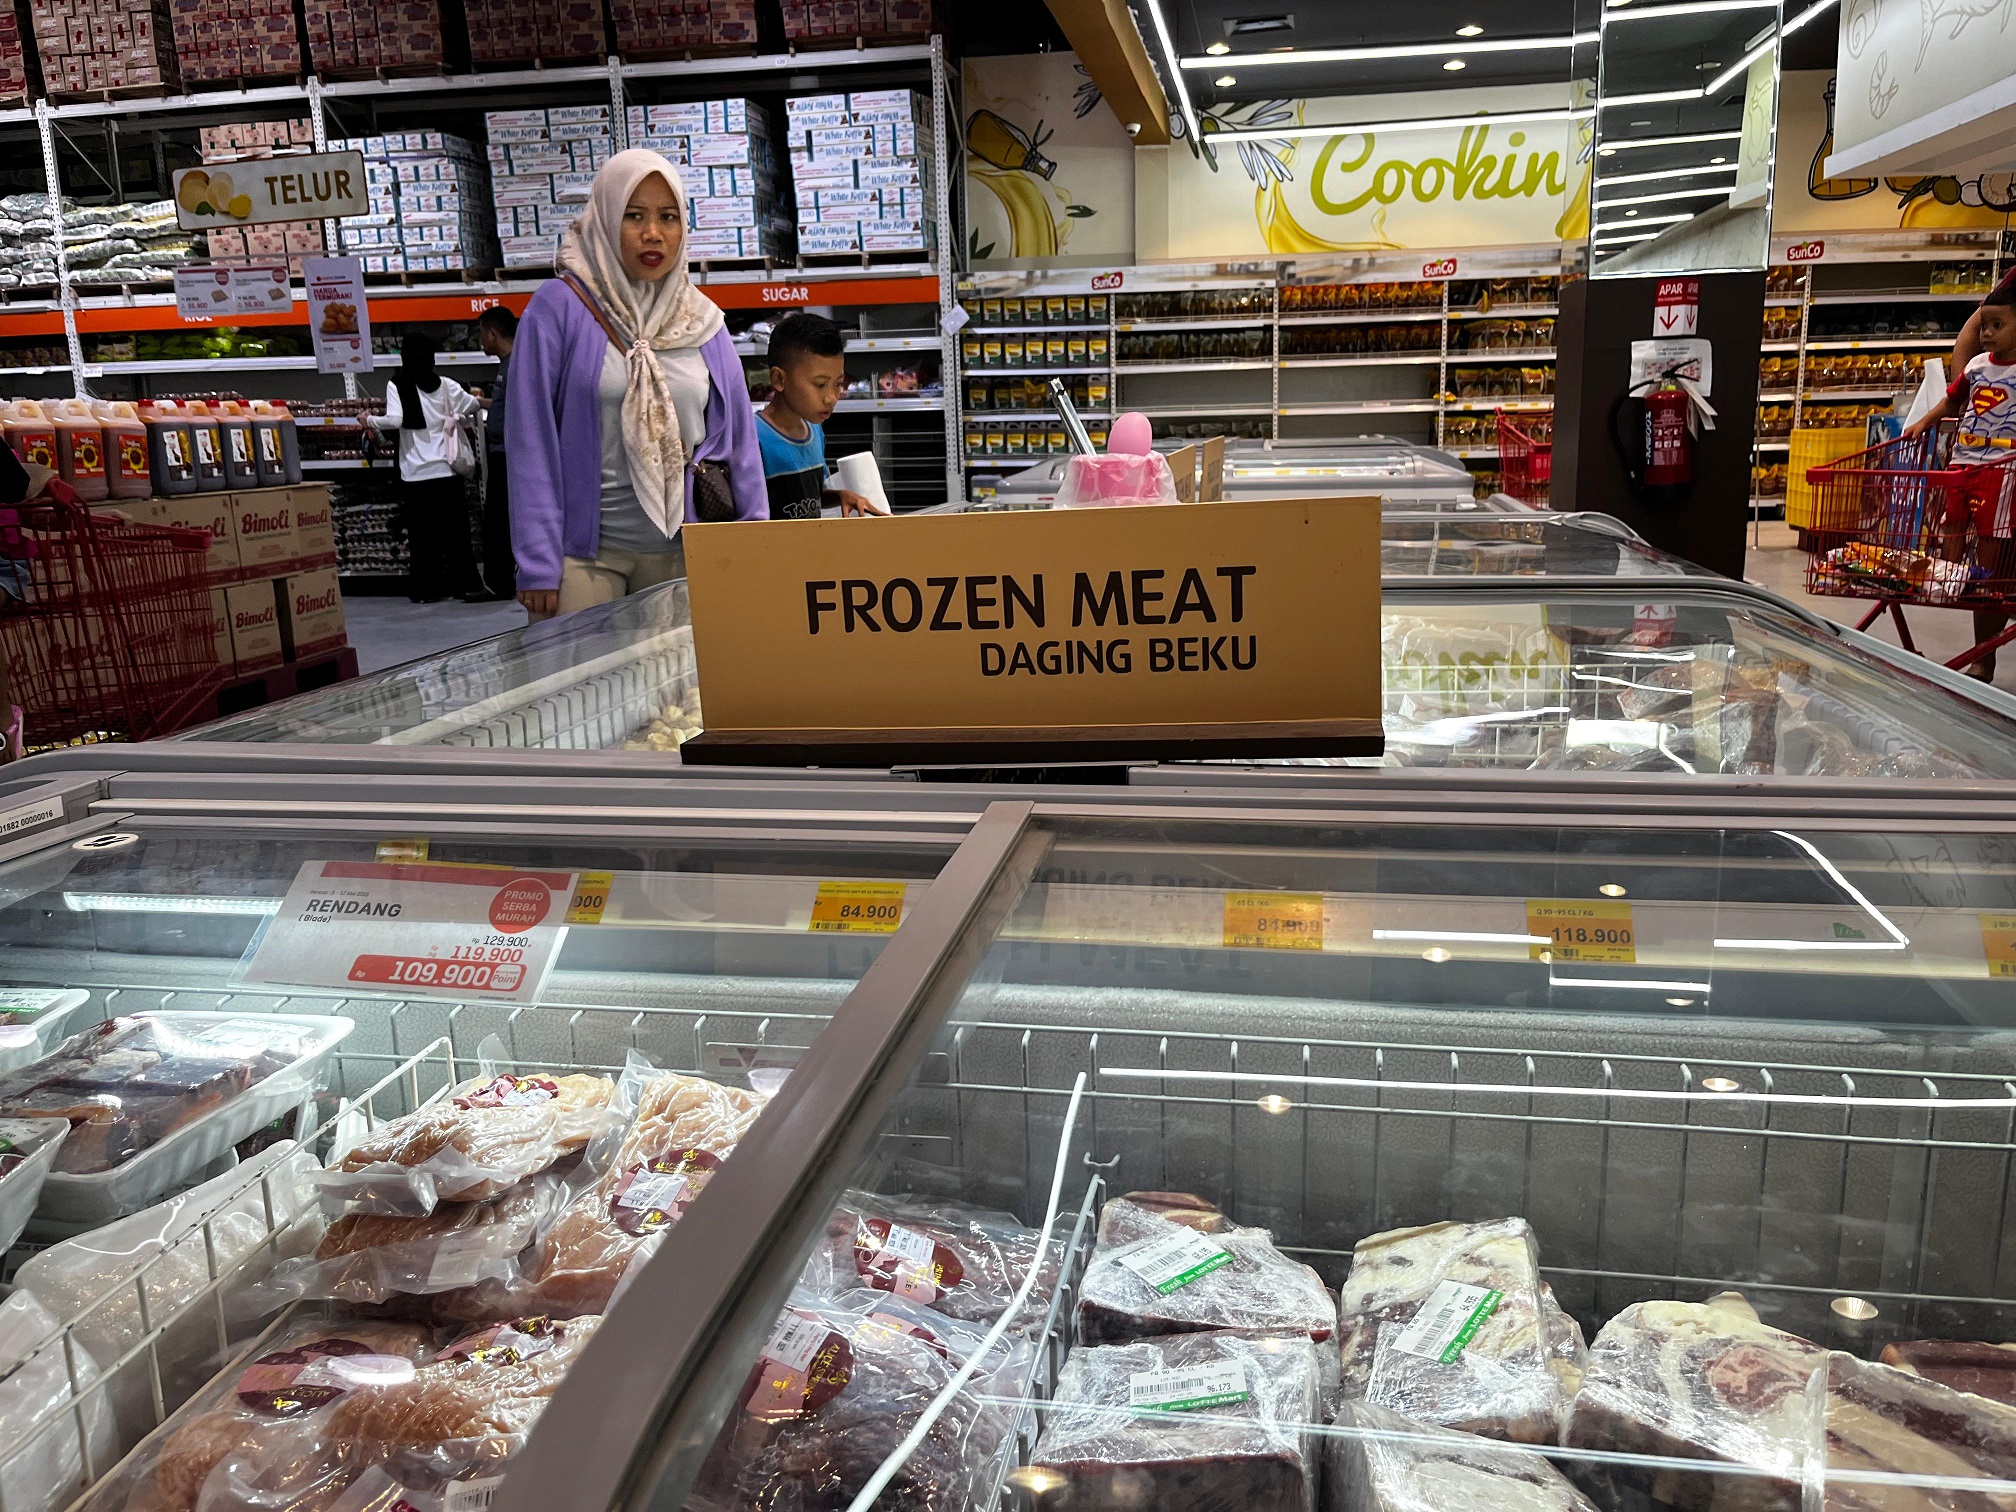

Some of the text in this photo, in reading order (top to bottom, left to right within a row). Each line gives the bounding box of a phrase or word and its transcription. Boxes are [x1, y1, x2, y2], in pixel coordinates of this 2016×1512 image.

[40, 20, 56, 28] ABC
[44, 38, 59, 46] ABC
[131, 49, 148, 58] ABC
[136, 68, 152, 76] ABC
[561, 107, 599, 119] White Koffie
[802, 114, 839, 125] White Koffie
[500, 128, 539, 138] White Koffie
[562, 124, 600, 135] White Koffie
[824, 128, 862, 140] White Koffie
[521, 144, 559, 154] White Koffie
[642, 139, 678, 148] White Koffie
[826, 146, 863, 156] White Koffie
[564, 174, 583, 184] White
[872, 174, 910, 184] White Koffie
[264, 169, 353, 206] TELUR
[413, 182, 448, 193] White Koffie
[830, 190, 868, 201] White Koffie
[874, 220, 912, 230] White Koffie
[812, 239, 850, 250] White Koffie
[1789, 244, 1821, 260] SunCo
[1425, 261, 1454, 277] SunCo
[1093, 275, 1121, 289] SunCo
[762, 287, 809, 302] SUGAR
[1659, 283, 1683, 296] APAR
[471, 298, 500, 313] RICE
[241, 510, 290, 535] Bimoli
[297, 510, 328, 528] Bimoli
[296, 588, 336, 615] Bimoli
[804, 565, 1258, 635] FROZEN MEAT
[235, 606, 274, 628] Bimoli
[980, 634, 1258, 677] DAGING BEKU
[20, 809, 54, 827] 00000016
[504, 890, 544, 901] PROMO
[306, 899, 402, 918] RENDANG
[502, 902, 537, 912] SERBA
[840, 904, 898, 918] 84.900
[495, 913, 536, 923] MURAH
[482, 935, 528, 948] 129.900
[1552, 926, 1631, 944] 118.900
[450, 945, 524, 963] 119.900
[388, 961, 492, 987] 109.900
[492, 974, 518, 984] Point
[1160, 1278, 1183, 1293] Fresh
[1444, 1340, 1464, 1362] Fresh
[1470, 1306, 1488, 1329] LOTTE
[1486, 1292, 1500, 1308] Mart
[822, 1342, 841, 1368] ALICE
[1207, 1382, 1232, 1393] 96.173
[1188, 1398, 1218, 1408] LOTTE
[1219, 1394, 1243, 1402] Mart
